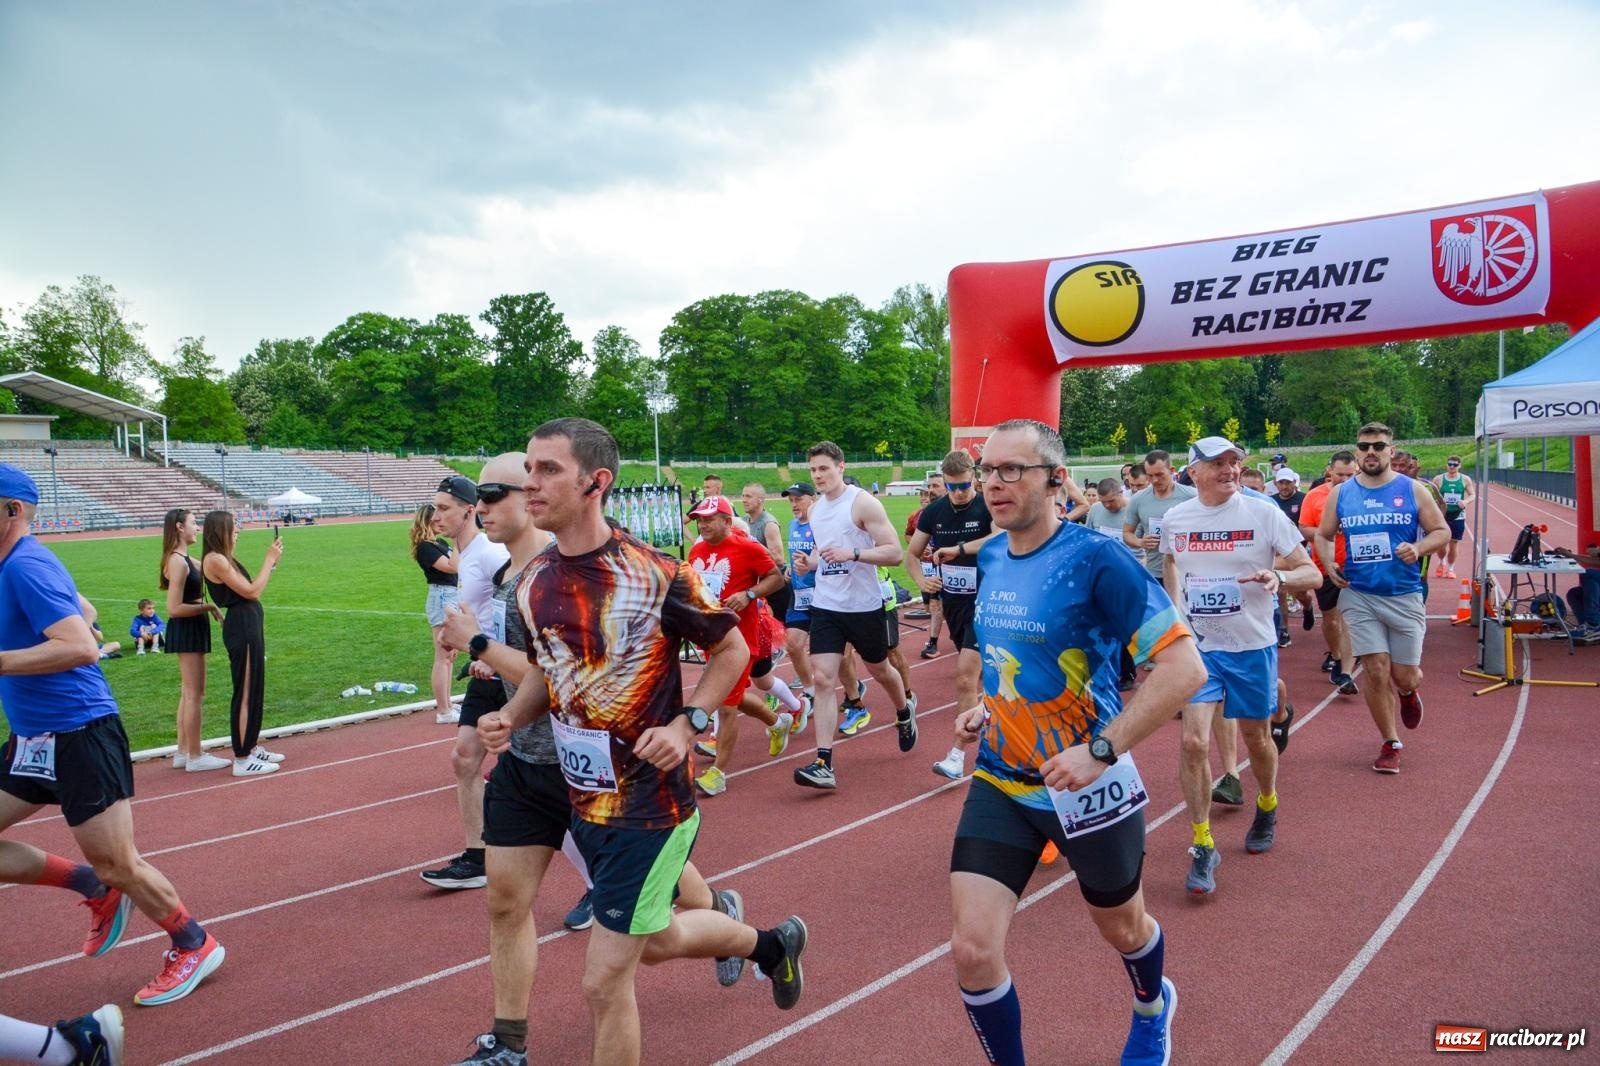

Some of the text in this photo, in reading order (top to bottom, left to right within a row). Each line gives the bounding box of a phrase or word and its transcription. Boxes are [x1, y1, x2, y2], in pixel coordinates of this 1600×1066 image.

[1232, 234, 1321, 262] BIEG
[1094, 267, 1142, 288] SIR
[1170, 256, 1389, 305] BEZ GRANIC
[1191, 298, 1373, 337] RACIBÓRZ
[1513, 399, 1600, 420] Person
[1341, 512, 1413, 528] RUNNERS
[1190, 530, 1253, 541] X BIEG BEZ
[1189, 541, 1233, 551] GRANIC
[1359, 544, 1380, 555] 258
[948, 576, 967, 587] 230
[1200, 592, 1227, 606] 152
[986, 602, 1028, 616] PIEKARSKI
[984, 616, 1046, 633] PÓŁMARATON
[566, 726, 577, 735] BEZ
[577, 730, 603, 739] GRANIC
[561, 746, 594, 775] 202
[1077, 780, 1124, 815] 270
